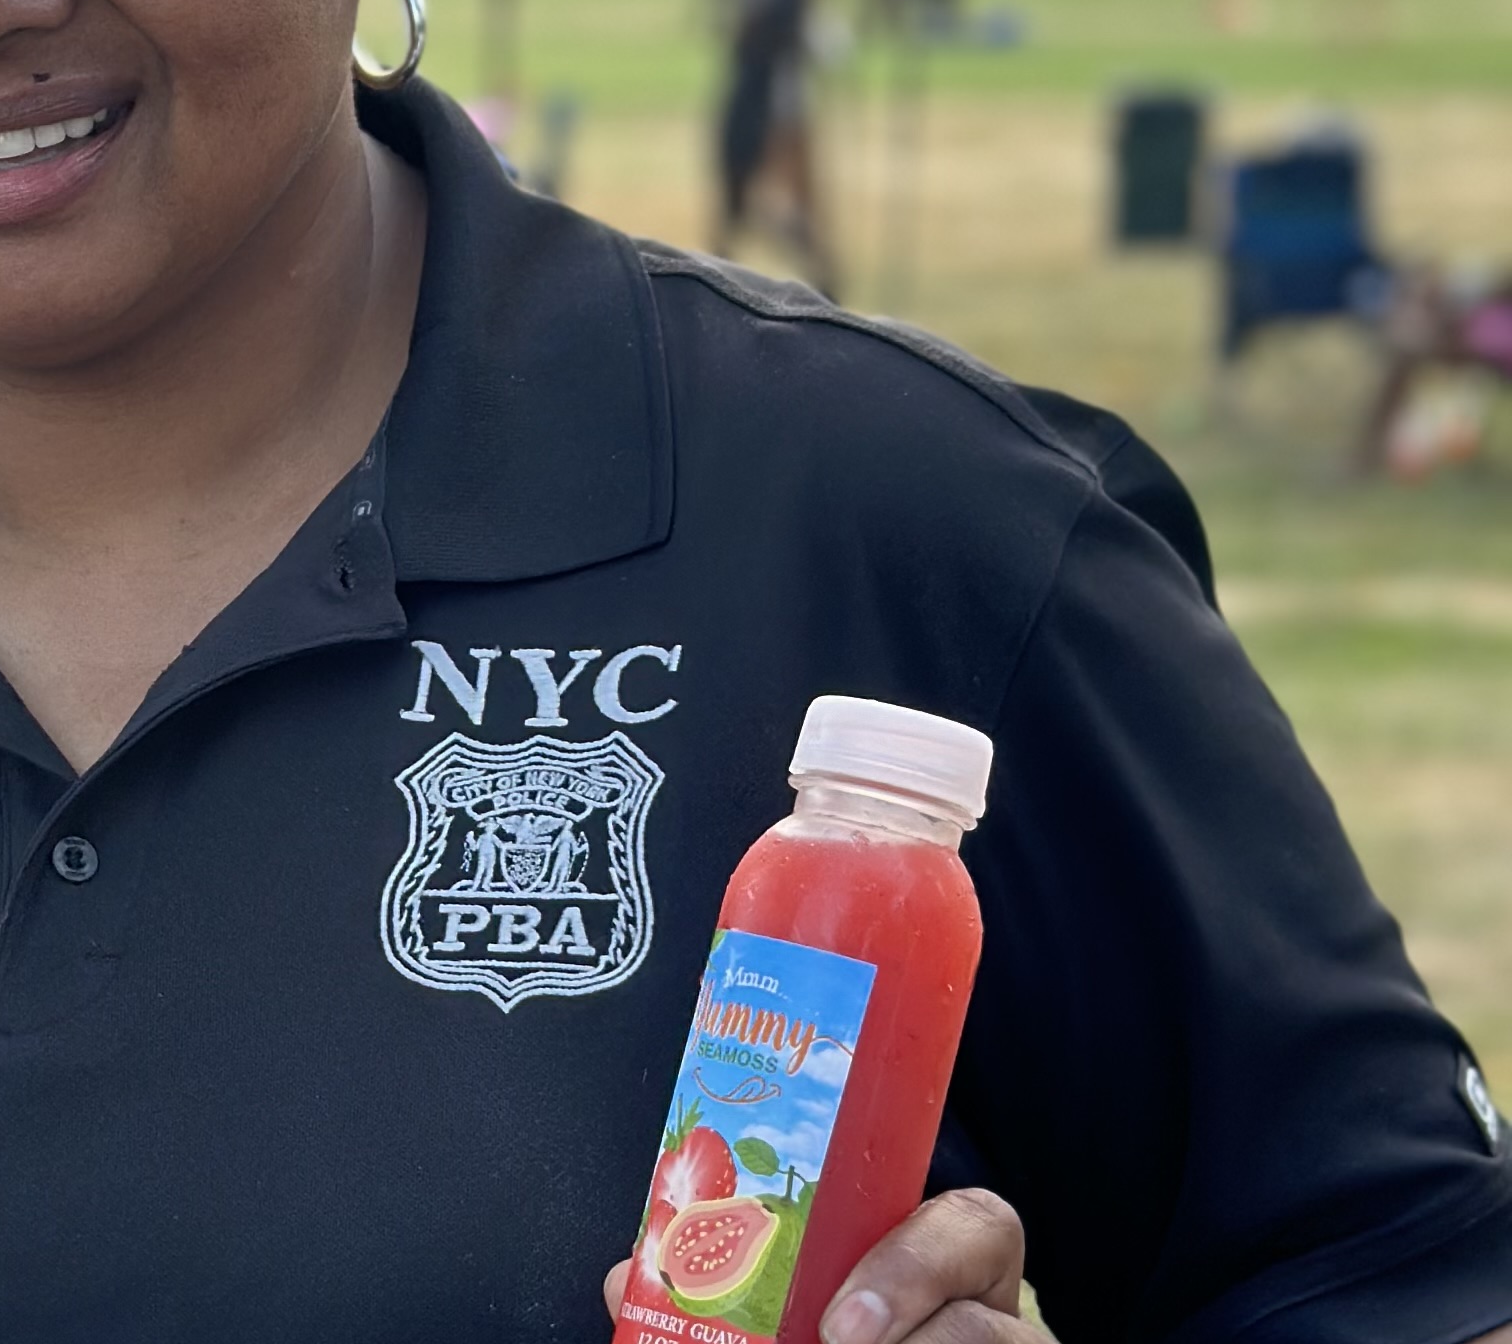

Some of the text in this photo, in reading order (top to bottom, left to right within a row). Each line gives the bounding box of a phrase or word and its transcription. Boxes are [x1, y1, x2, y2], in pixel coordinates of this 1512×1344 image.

[399, 640, 683, 727] NYC
[451, 769, 611, 803] CITY OF NEW YORK
[492, 789, 571, 810] POLICE
[433, 903, 596, 956] PBA
[696, 1039, 780, 1074] SEAMOSS
